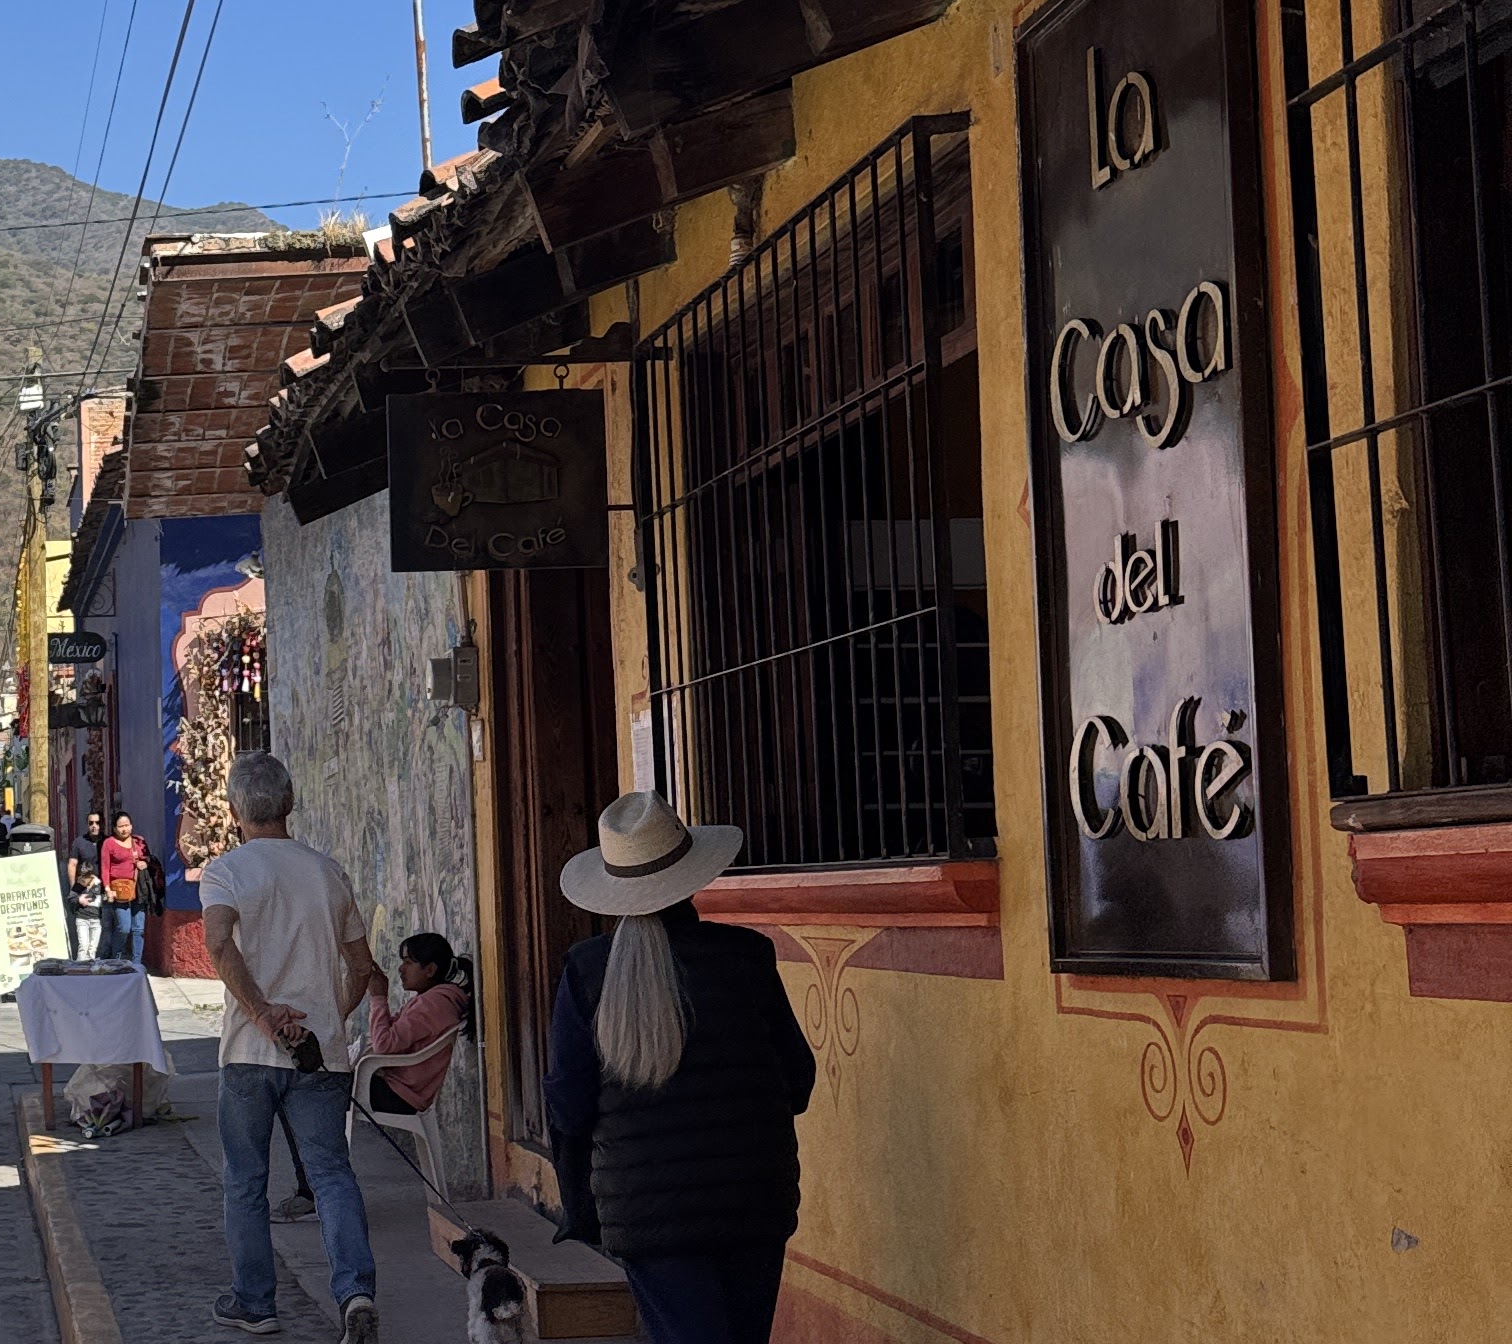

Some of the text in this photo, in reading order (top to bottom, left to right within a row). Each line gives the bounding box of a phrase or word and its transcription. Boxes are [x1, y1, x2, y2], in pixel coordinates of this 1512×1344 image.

[1086, 46, 1164, 191] La
[1050, 280, 1232, 450] Casa
[475, 404, 562, 442] Casa
[488, 515, 566, 558] Café
[1092, 518, 1182, 624] del
[49, 637, 101, 658] México
[1069, 696, 1250, 842] Café
[0, 887, 47, 904] BREAKFAST
